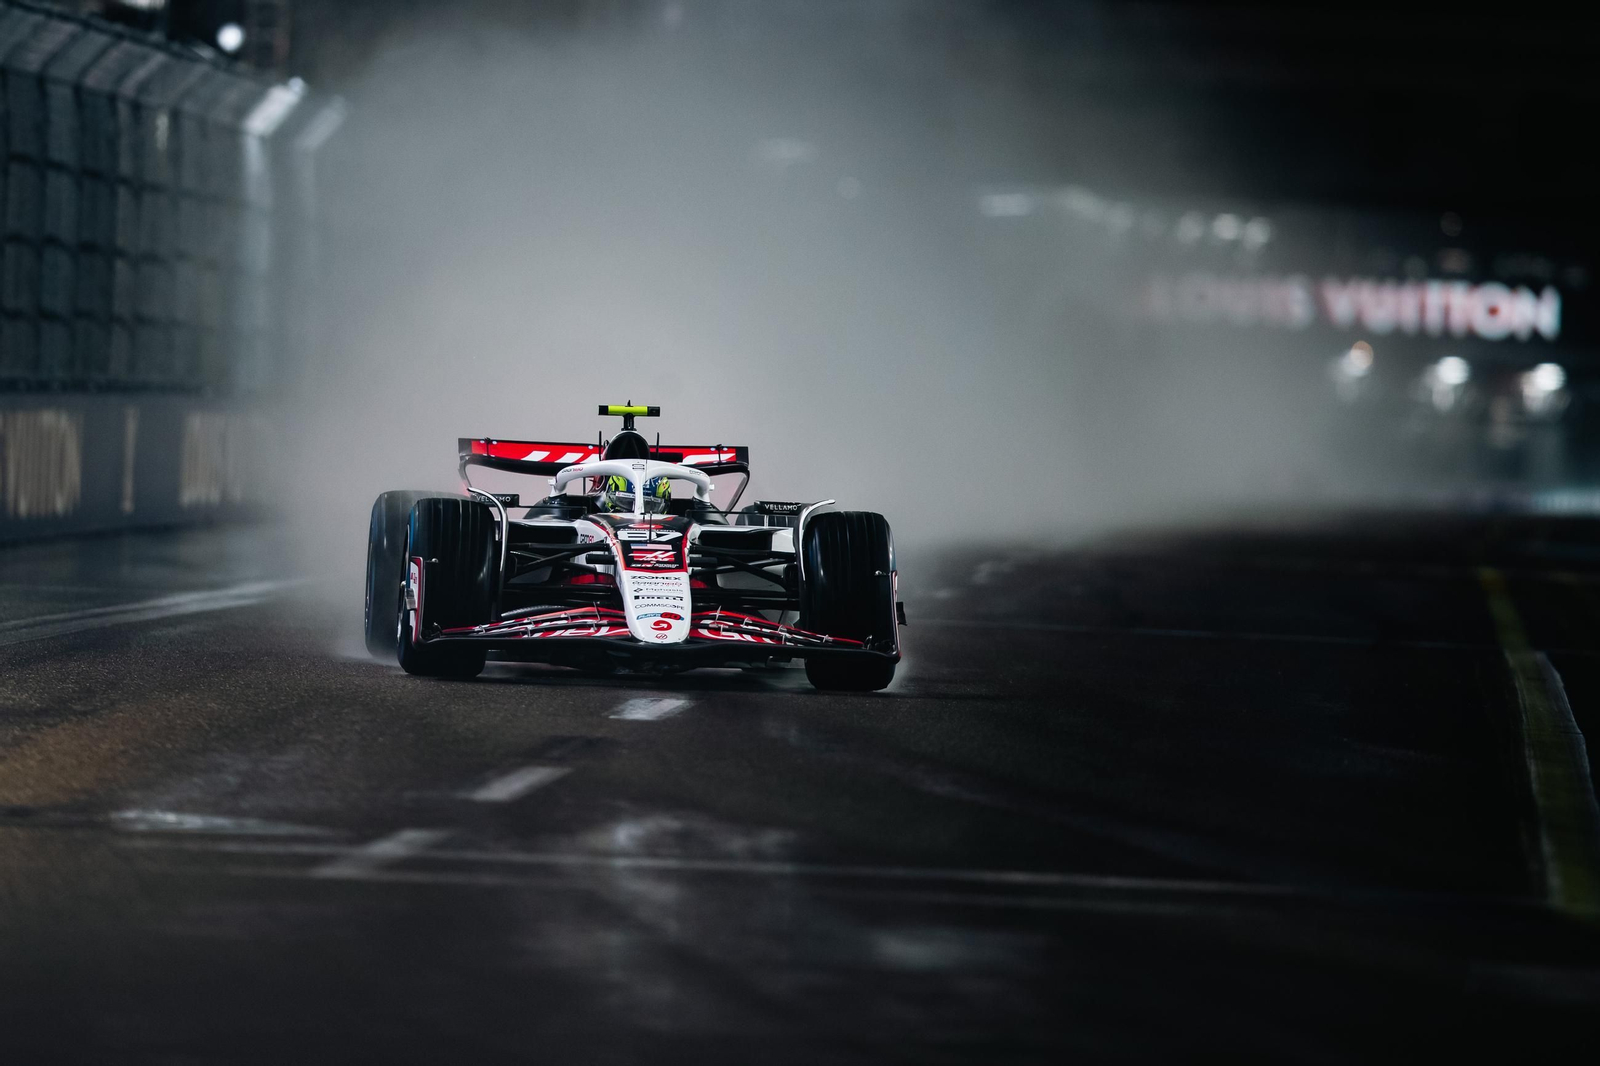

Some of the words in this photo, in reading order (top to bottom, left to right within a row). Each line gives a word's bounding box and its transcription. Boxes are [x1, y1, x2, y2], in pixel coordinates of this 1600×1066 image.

[1321, 276, 1562, 340] VUITTON
[764, 503, 798, 511] VELLAMO
[617, 530, 683, 542] 87
